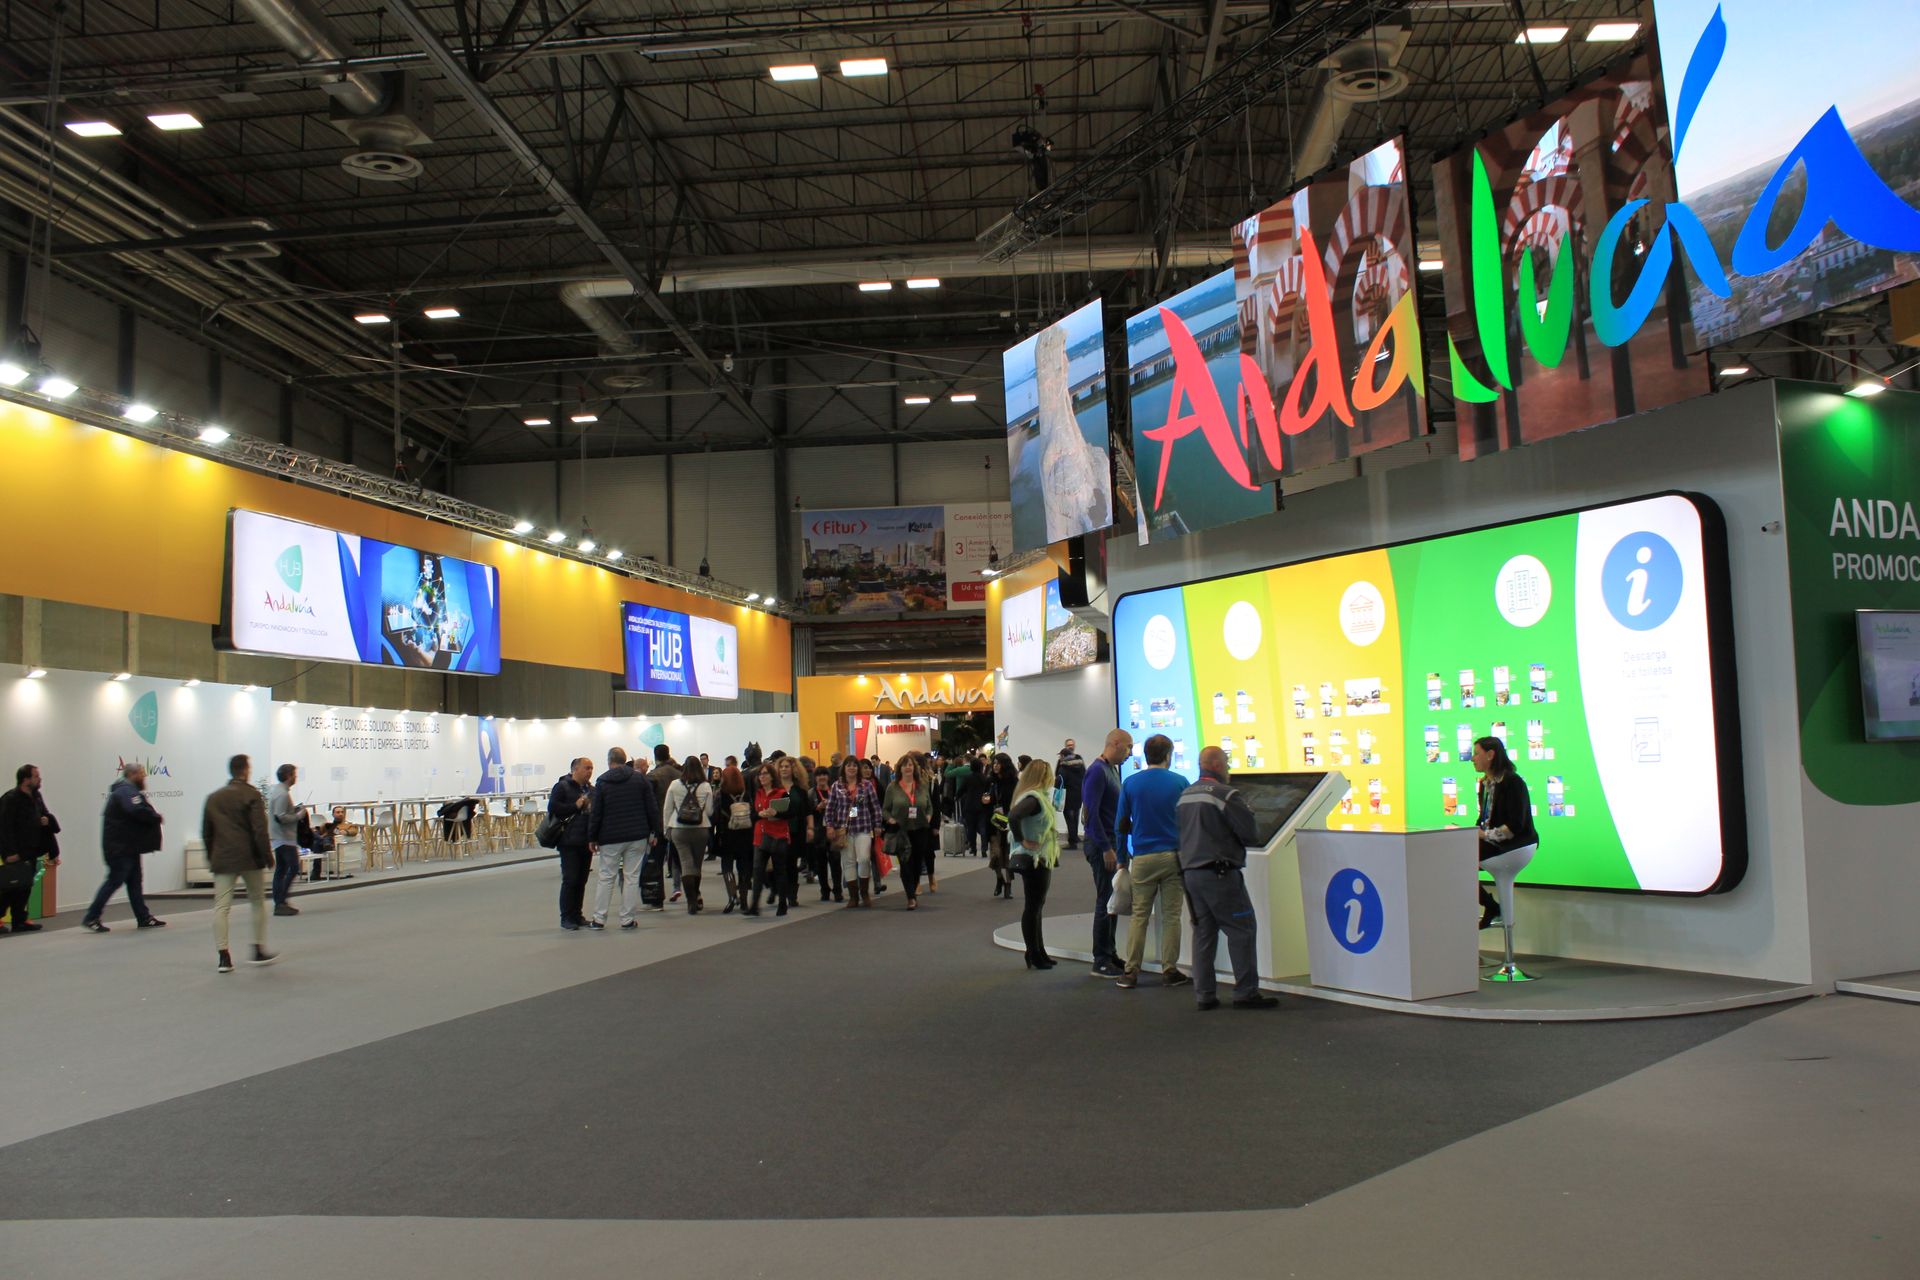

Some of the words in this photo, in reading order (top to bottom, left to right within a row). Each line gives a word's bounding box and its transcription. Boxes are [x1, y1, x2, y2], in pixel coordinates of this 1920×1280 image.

[1829, 497, 1920, 540] ANDA
[955, 542, 964, 555] 3
[280, 558, 302, 577] HUB
[264, 590, 316, 618] Andalucía
[649, 628, 683, 669] HUB
[650, 669, 683, 682] INTERNACIONAL
